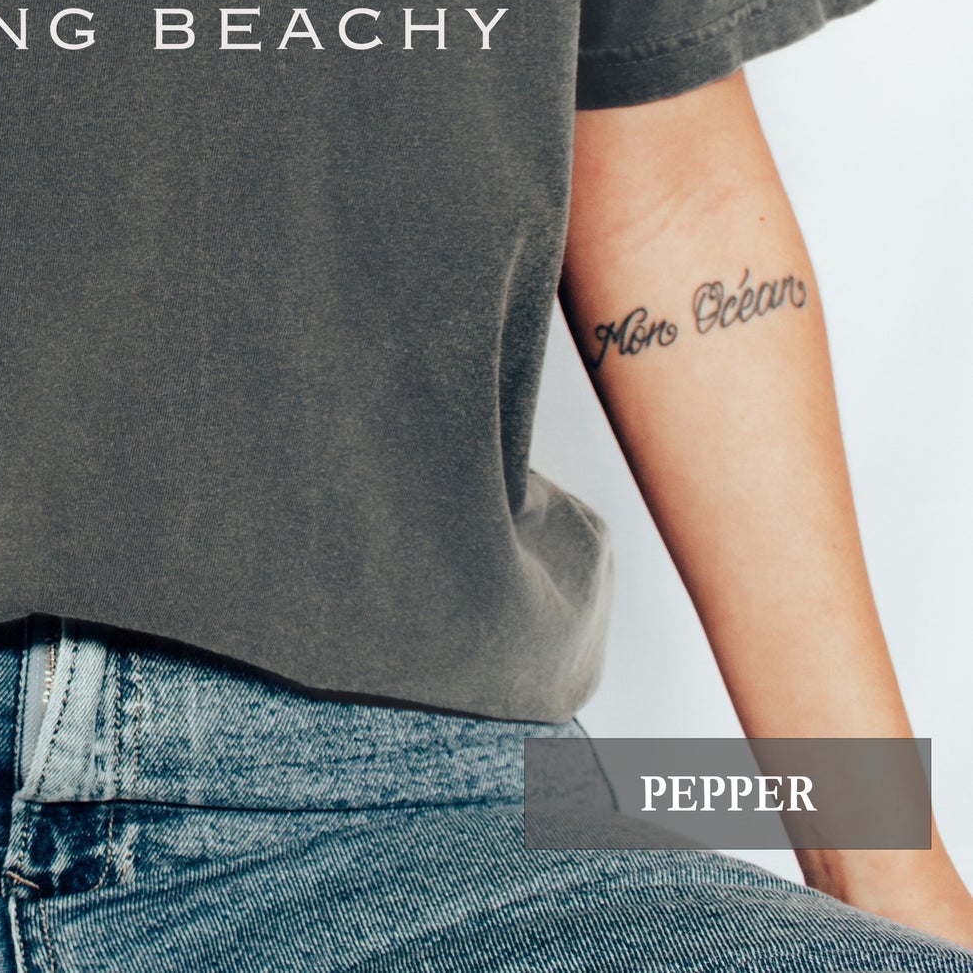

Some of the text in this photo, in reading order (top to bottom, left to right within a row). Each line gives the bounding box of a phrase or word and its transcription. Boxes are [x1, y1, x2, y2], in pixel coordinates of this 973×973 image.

[153, 6, 509, 52] BEACHY
[595, 268, 807, 369] Mon Océan
